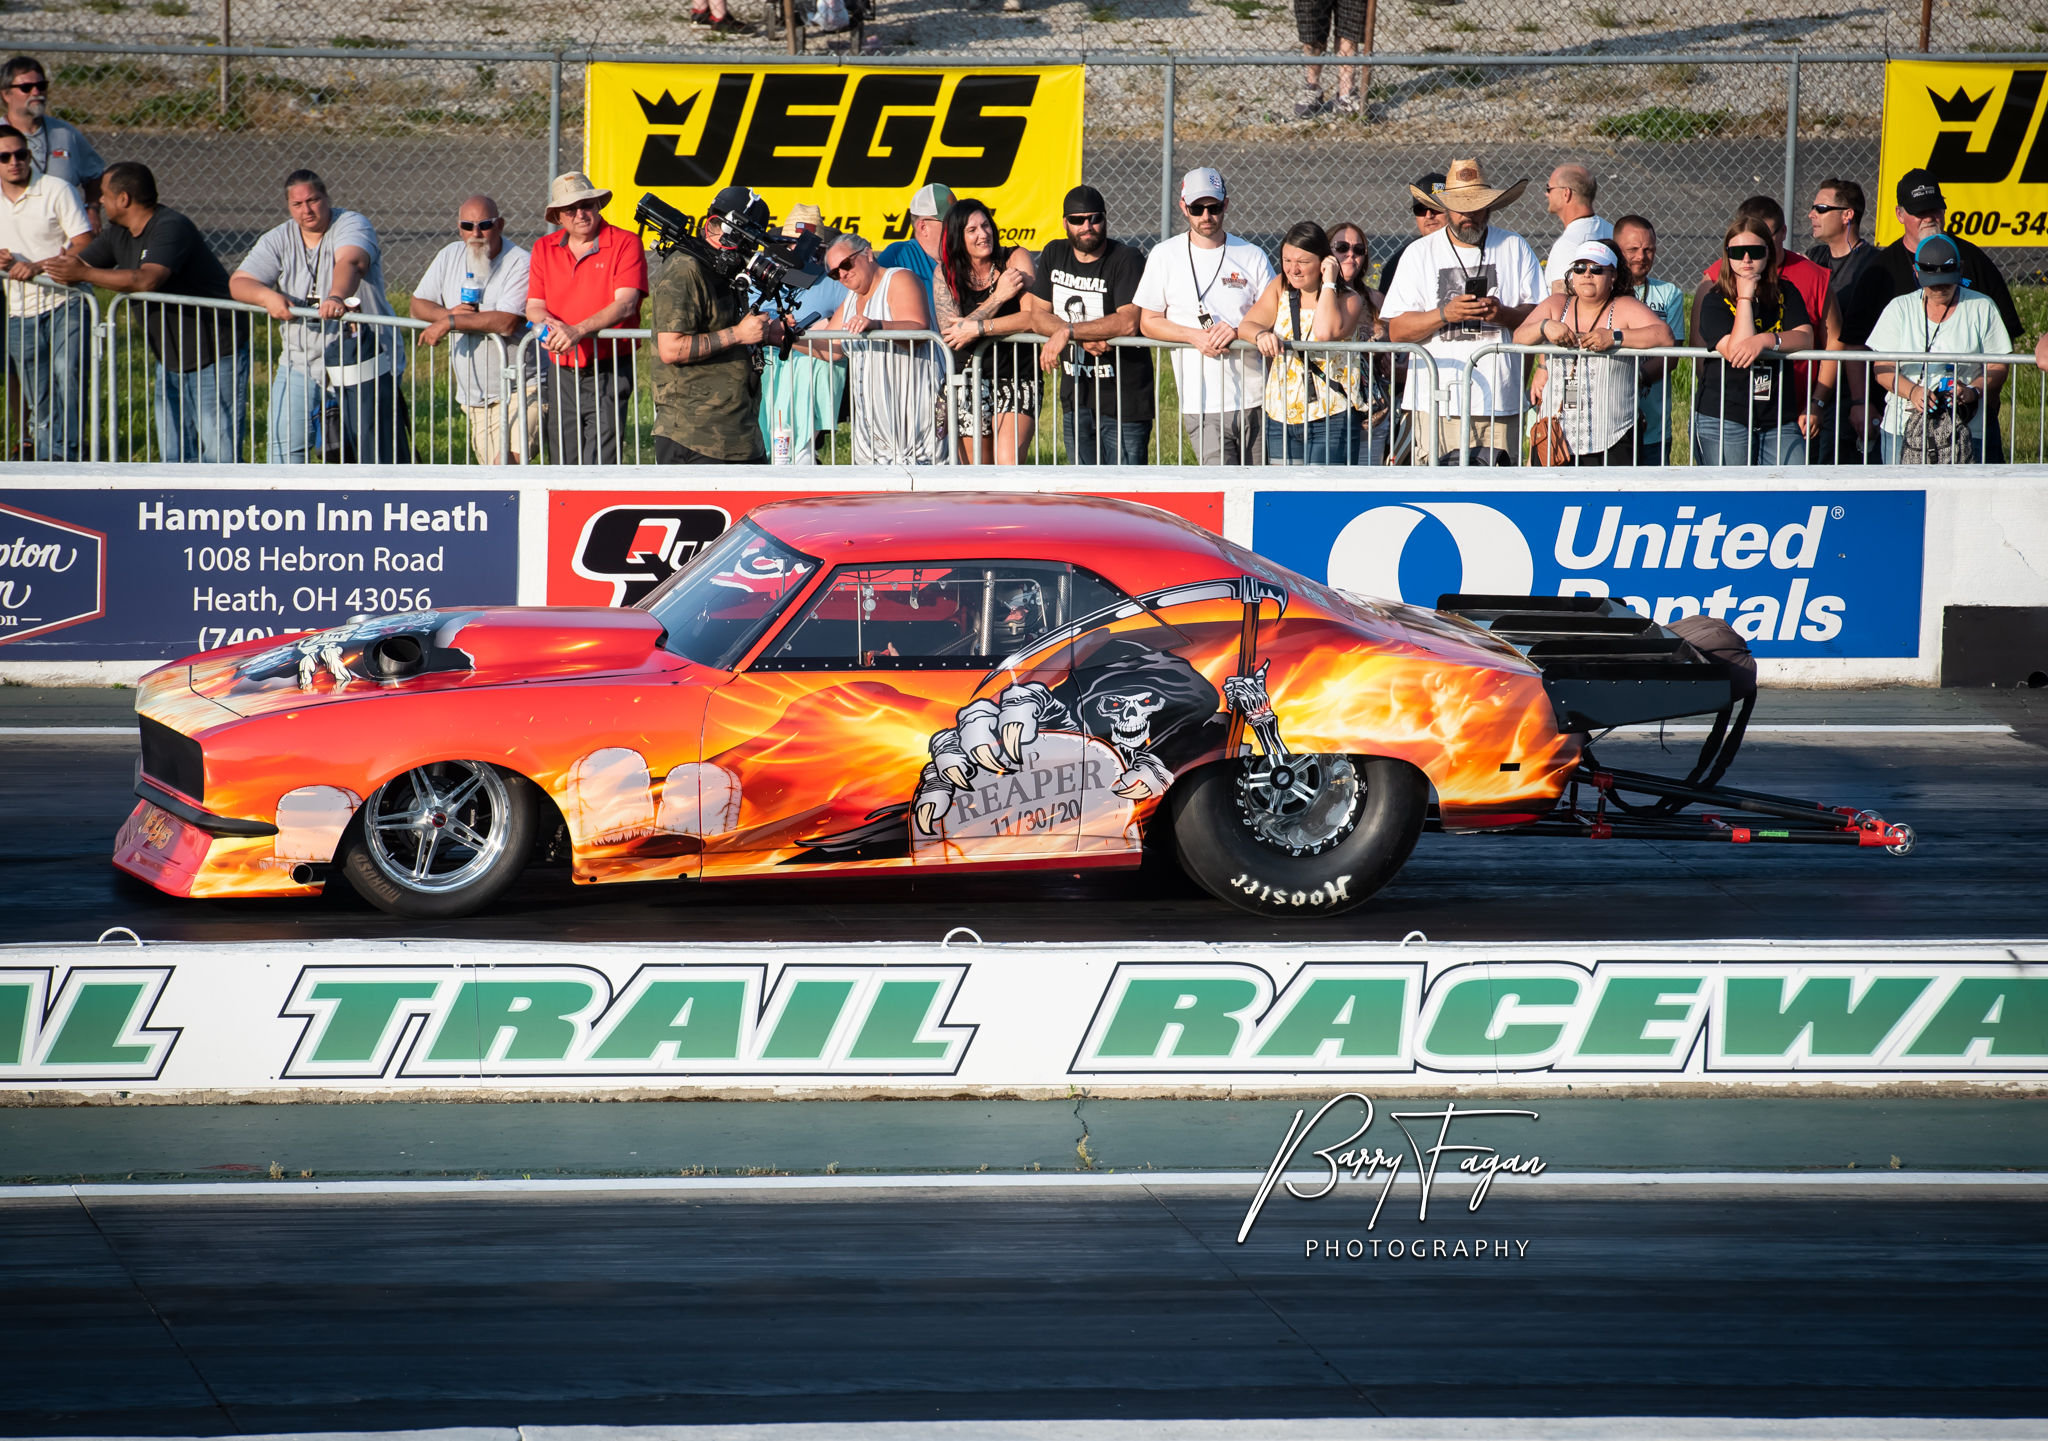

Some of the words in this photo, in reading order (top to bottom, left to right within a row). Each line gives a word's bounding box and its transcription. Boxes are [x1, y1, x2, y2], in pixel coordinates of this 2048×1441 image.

[634, 73, 1041, 187] JEGS
[1050, 268, 1108, 293] CRIMINAL
[1753, 374, 1770, 386] VIP
[137, 501, 307, 538] Hampton
[316, 502, 374, 531] Inn
[382, 501, 489, 532] Heath
[1553, 505, 1829, 571] United
[183, 546, 251, 571] 1008
[258, 545, 365, 571] Hebron
[373, 546, 445, 571] Road
[193, 586, 285, 616] Heath,
[292, 587, 337, 612] OH
[344, 587, 433, 612] 43056
[953, 758, 1106, 826] REAPER
[990, 798, 1082, 838] 11/30/20
[1230, 873, 1352, 909] Hoosier
[288, 968, 968, 1074] TRAIL
